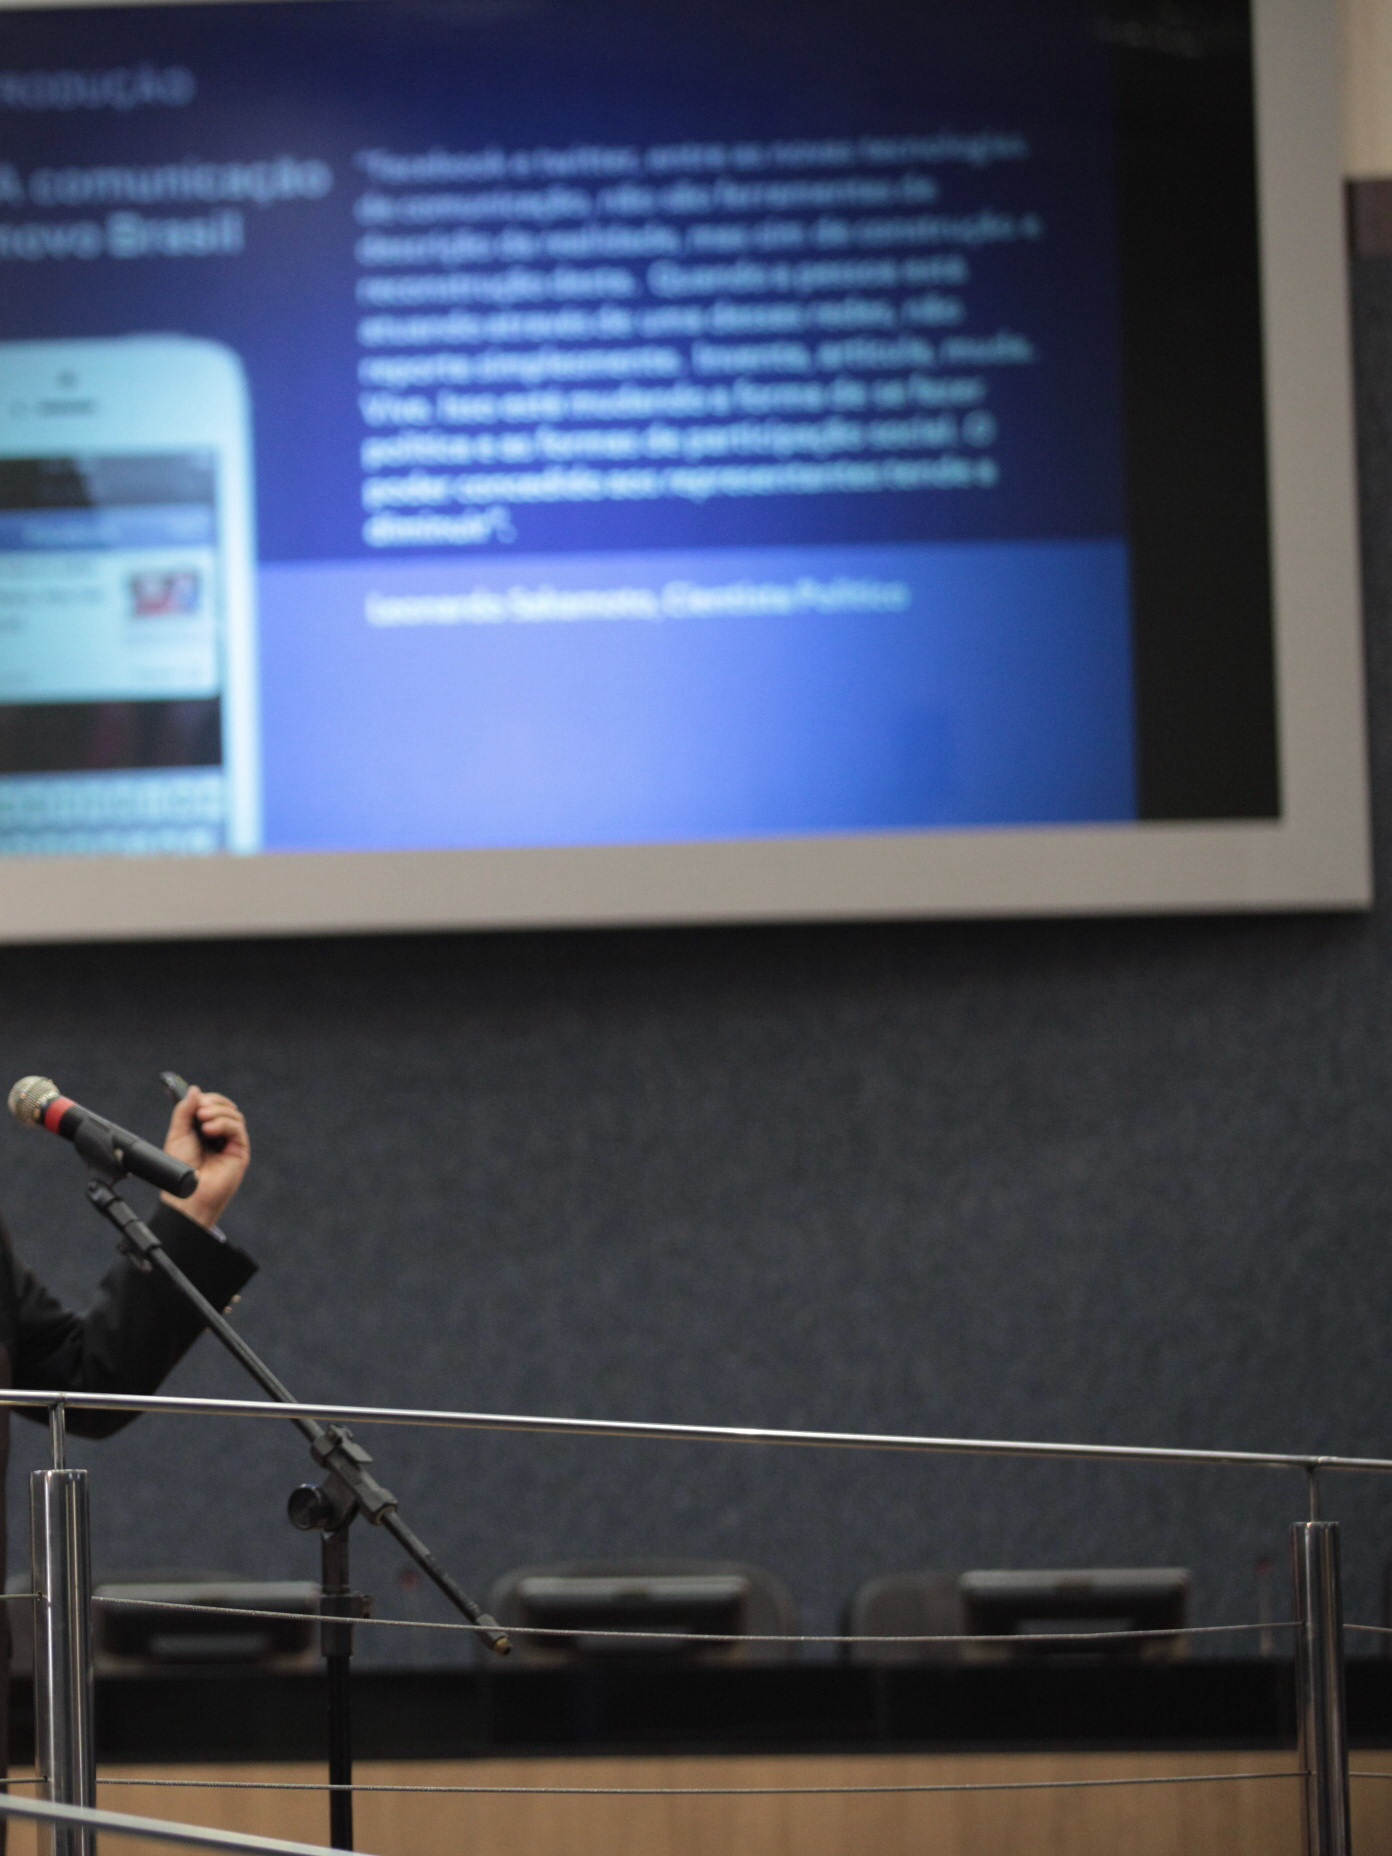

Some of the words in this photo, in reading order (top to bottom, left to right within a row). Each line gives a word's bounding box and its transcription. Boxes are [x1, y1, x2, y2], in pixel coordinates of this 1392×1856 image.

[26, 155, 333, 207] comunicação
[107, 207, 245, 259] Brasil
[962, 411, 997, 448] O
[367, 588, 505, 628] Leonardo
